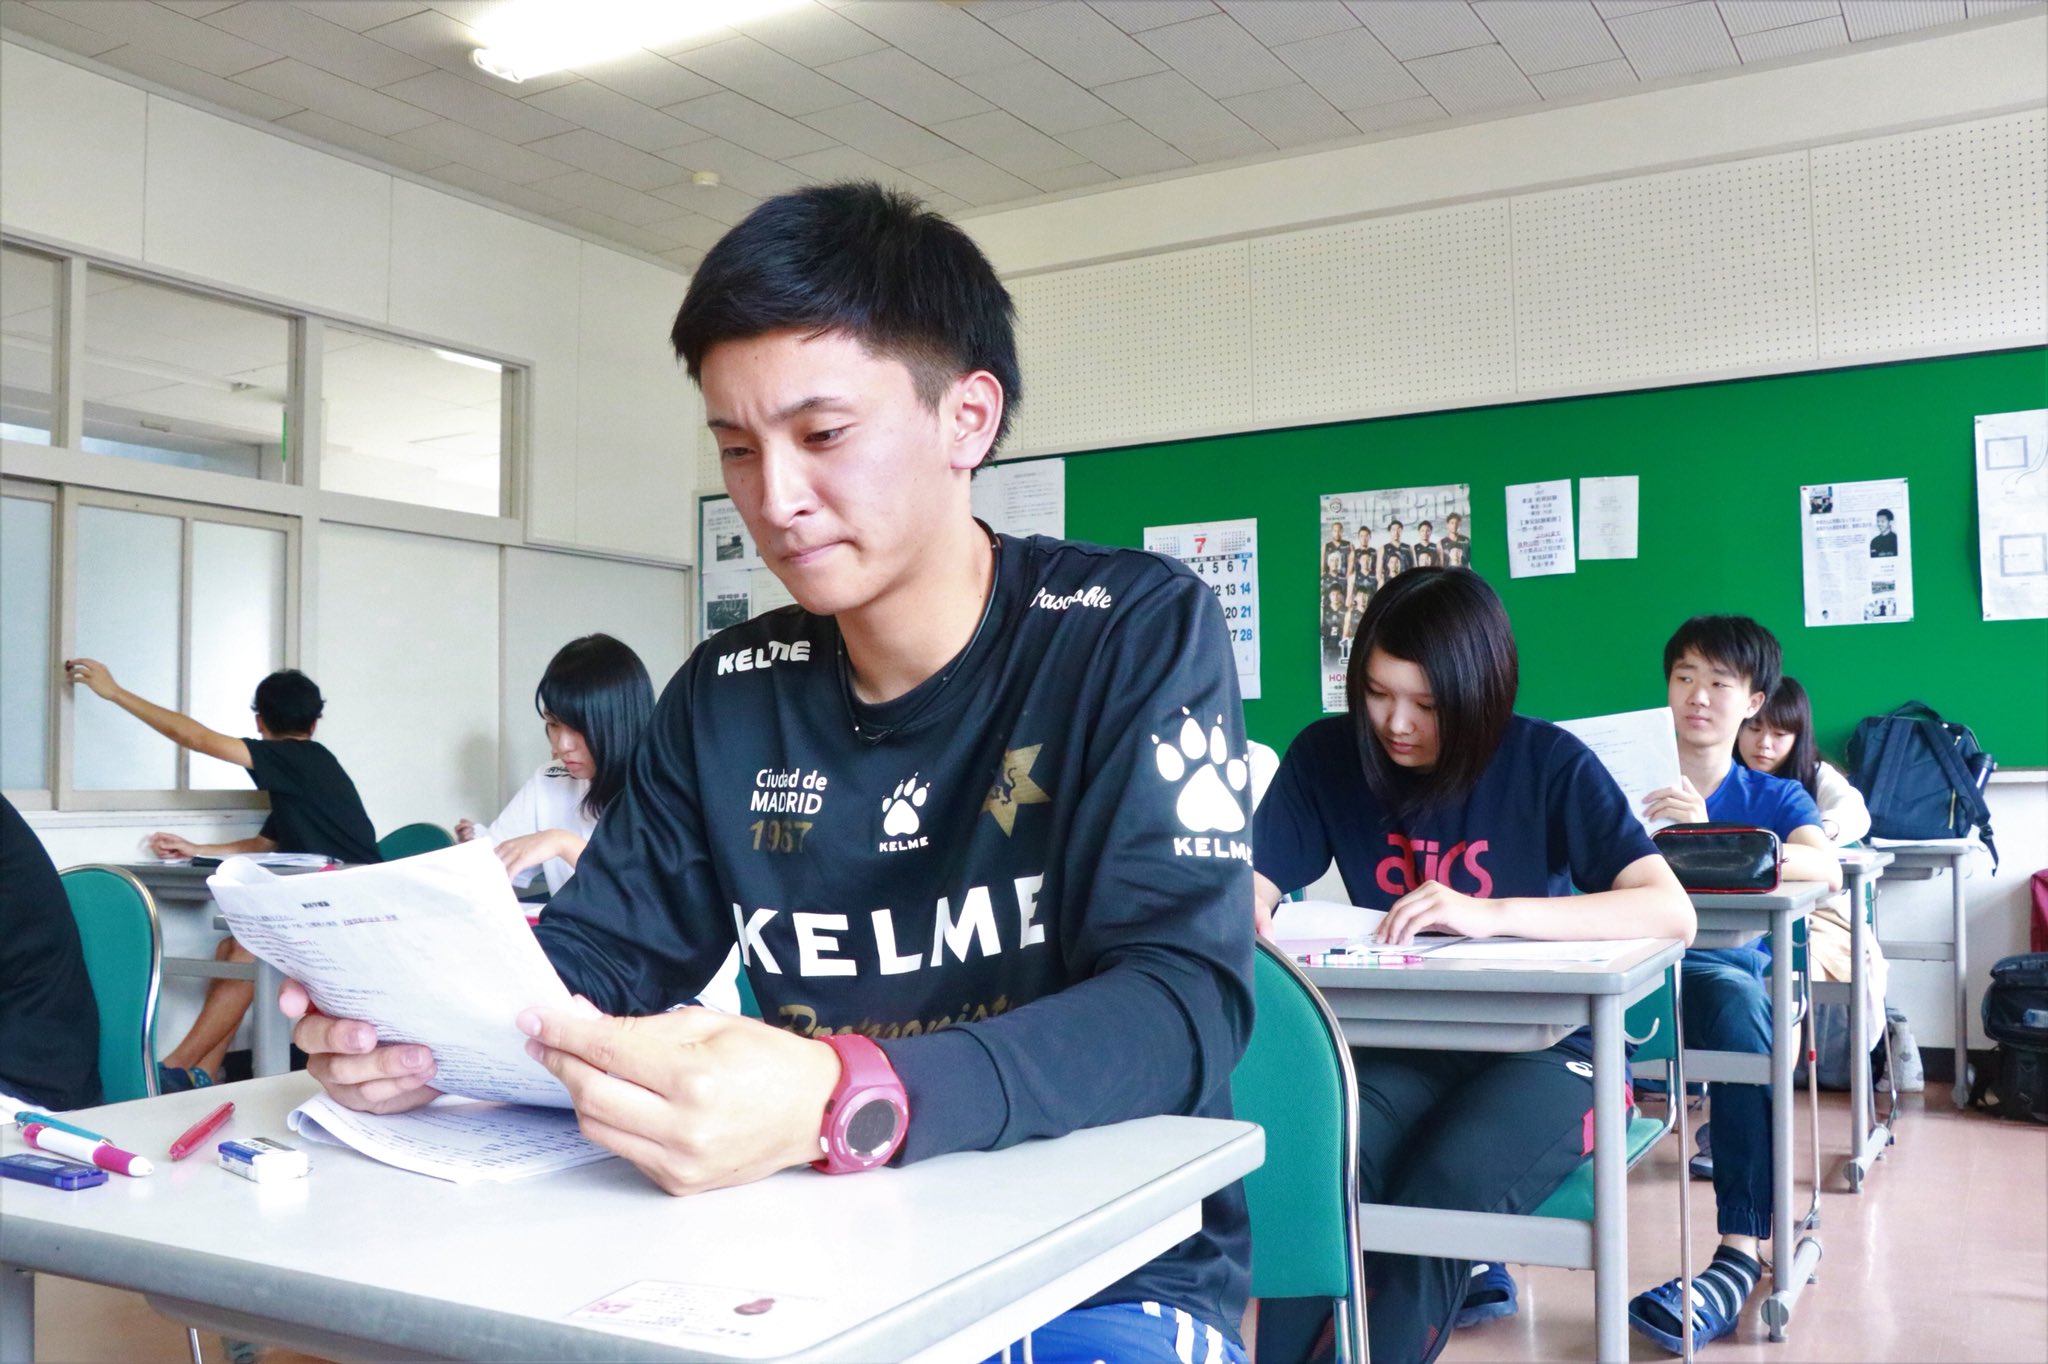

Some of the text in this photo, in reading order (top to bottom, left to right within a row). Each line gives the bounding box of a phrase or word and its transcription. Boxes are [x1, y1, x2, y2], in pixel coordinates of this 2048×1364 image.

[1193, 536, 1208, 554] 7
[1197, 559, 1249, 575] 4 5 6 7
[1224, 583, 1237, 596] 13
[1239, 582, 1252, 595] 14
[1225, 605, 1252, 619] 20 21
[1239, 628, 1253, 642] 28
[755, 767, 828, 791] Ciudad de
[750, 790, 823, 815] MADRID
[879, 836, 929, 852] KELME
[1375, 833, 1493, 899] aics
[732, 871, 1046, 977] KELME
